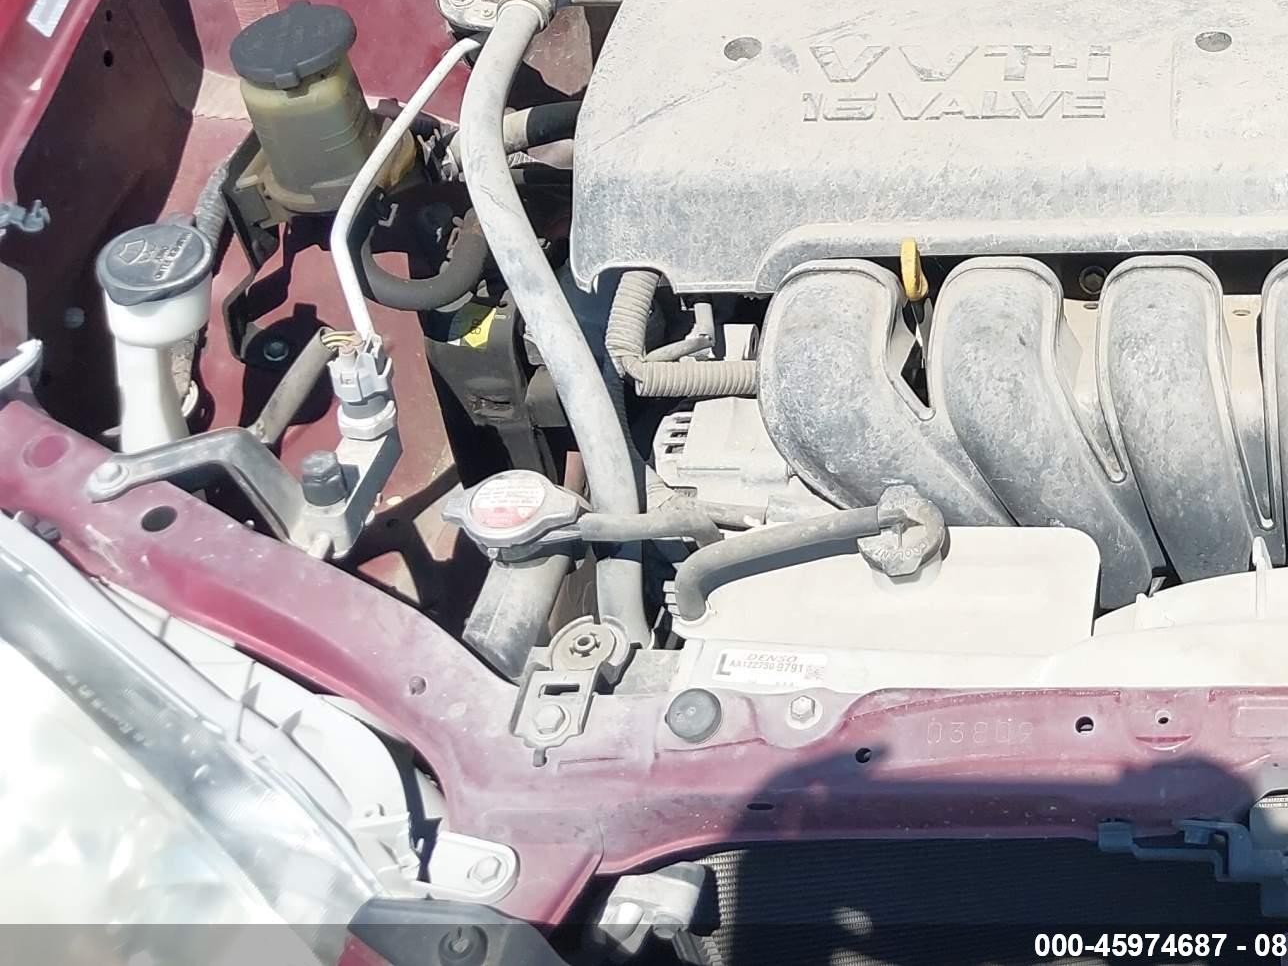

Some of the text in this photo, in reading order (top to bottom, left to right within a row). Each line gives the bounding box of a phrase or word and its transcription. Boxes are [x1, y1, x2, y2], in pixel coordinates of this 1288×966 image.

[802, 90, 1106, 122] 16 VALVE
[716, 653, 731, 675] L
[747, 653, 798, 663] DENSO
